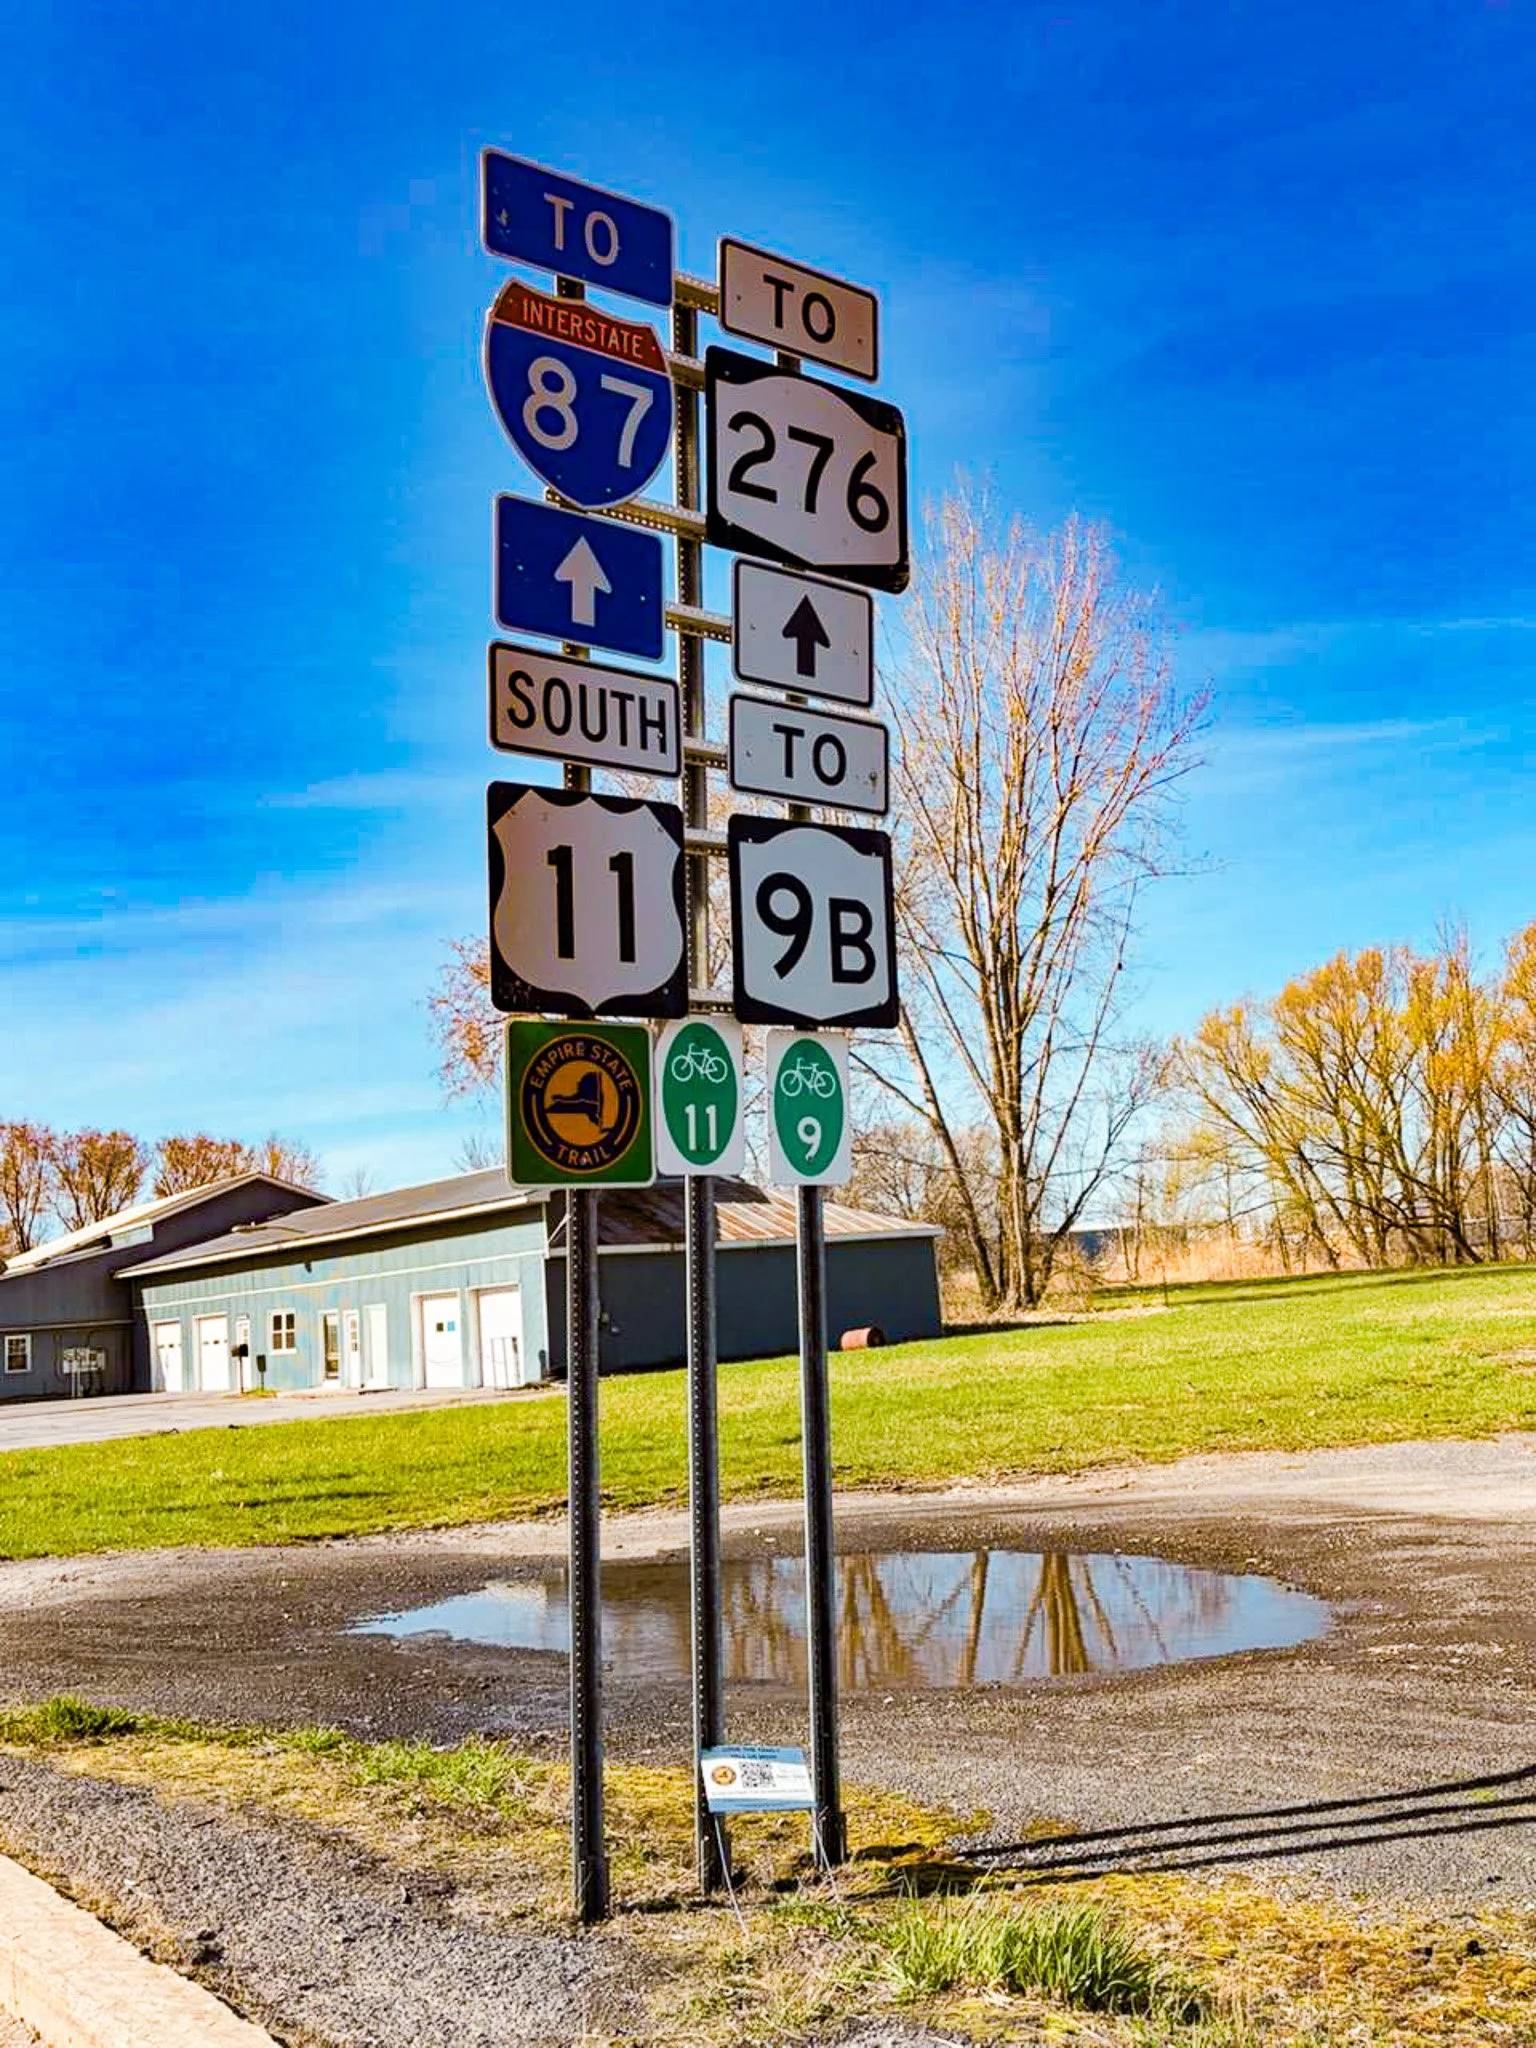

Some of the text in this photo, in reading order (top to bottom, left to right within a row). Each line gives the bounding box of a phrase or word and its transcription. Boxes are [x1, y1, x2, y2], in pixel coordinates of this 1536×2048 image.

[544, 193, 619, 266] TO
[522, 298, 644, 360] INTERSTATE
[763, 274, 836, 344] TO
[522, 356, 654, 468] 87
[728, 411, 890, 534] 276
[507, 670, 667, 754] SOUTH
[773, 724, 846, 786] TO
[547, 845, 636, 963] 11
[756, 872, 876, 984] 9B
[529, 1041, 633, 1092] EMPIRE STATE
[555, 1143, 612, 1166] TRAIL
[685, 1103, 717, 1152] 11
[797, 1116, 822, 1163] 9
